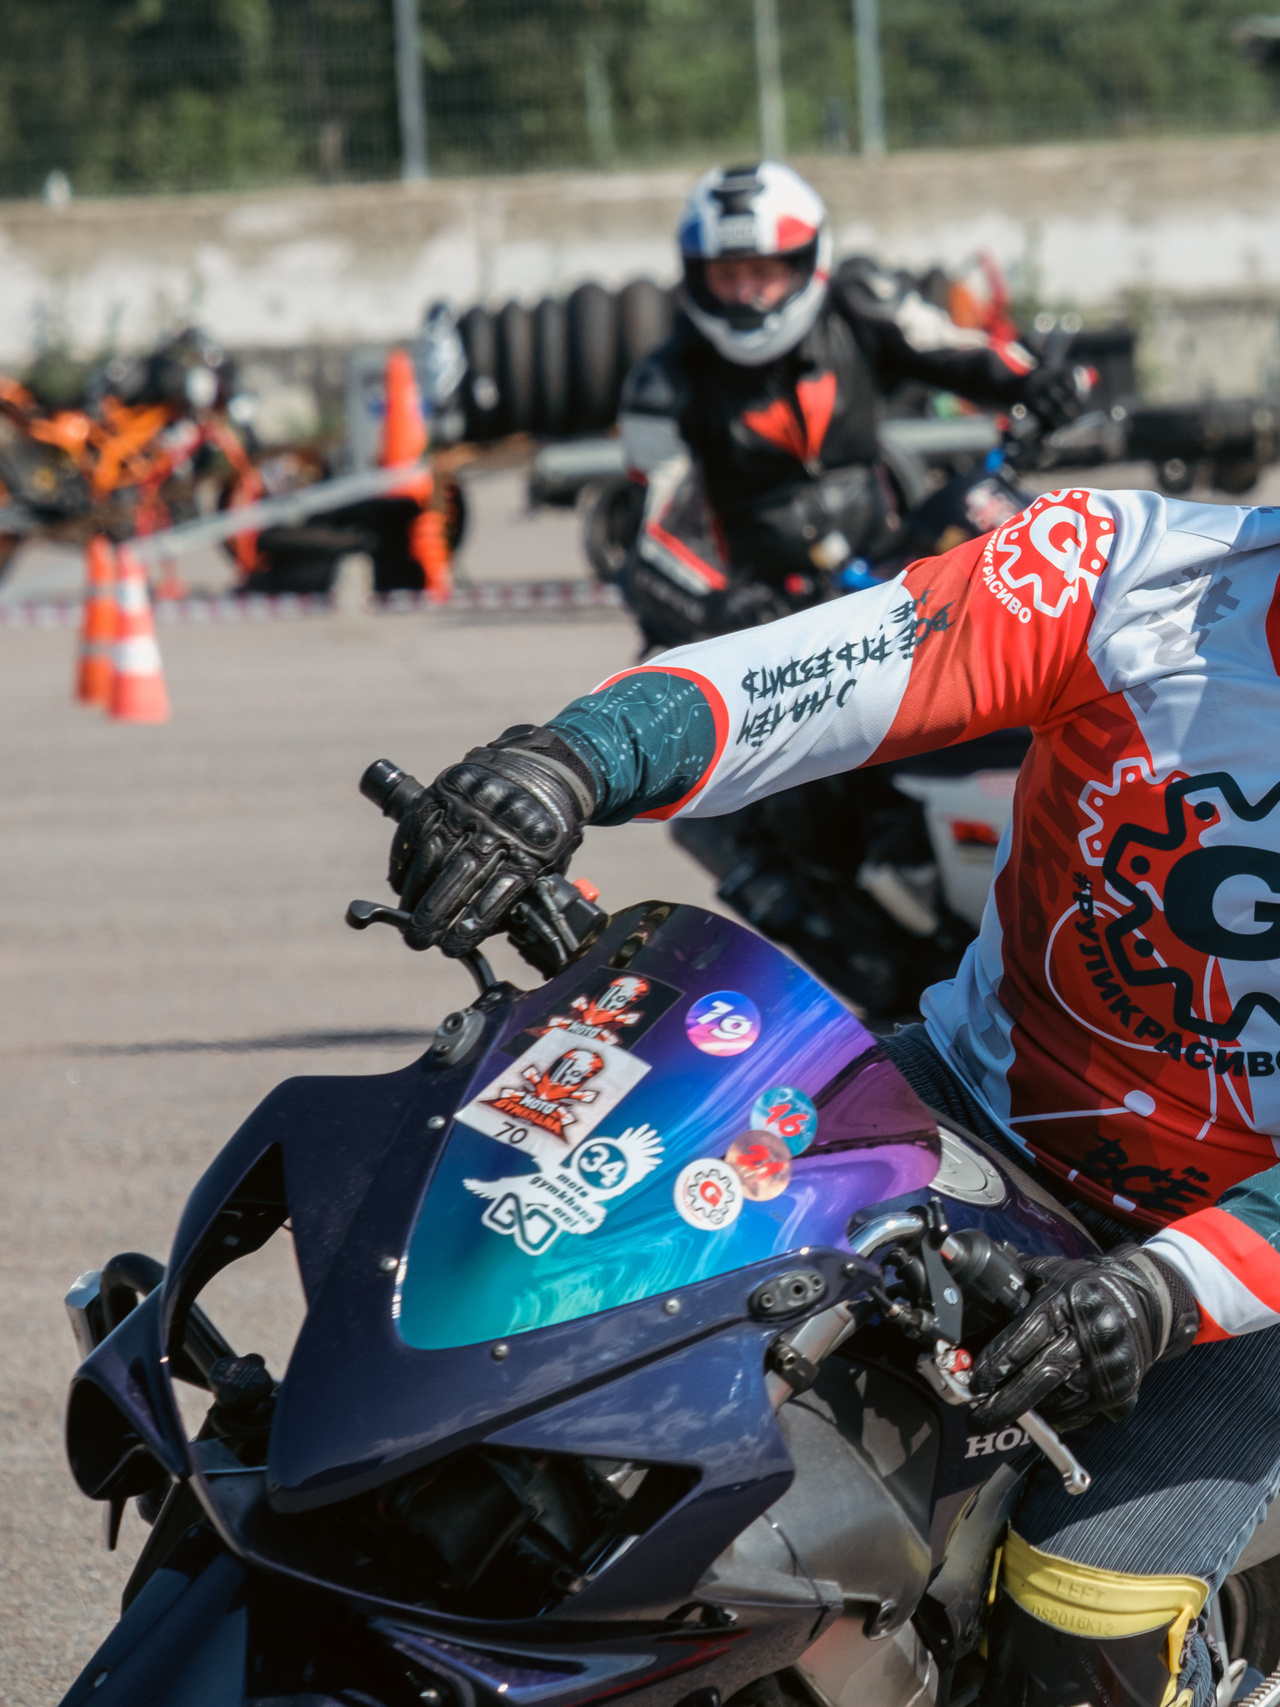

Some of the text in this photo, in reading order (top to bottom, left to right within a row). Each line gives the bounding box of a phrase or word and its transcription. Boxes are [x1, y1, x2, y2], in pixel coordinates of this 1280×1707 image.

[741, 645, 836, 705] ЕЗДИТЬ
[518, 1094, 559, 1115] MOTO
[766, 1103, 809, 1138] 16
[495, 1121, 528, 1144] 70
[580, 1145, 626, 1188] 34
[736, 1145, 786, 1180] 21
[529, 1176, 596, 1225] gymkhana
[556, 1173, 589, 1198] moto
[1056, 1577, 1106, 1604] LEFT
